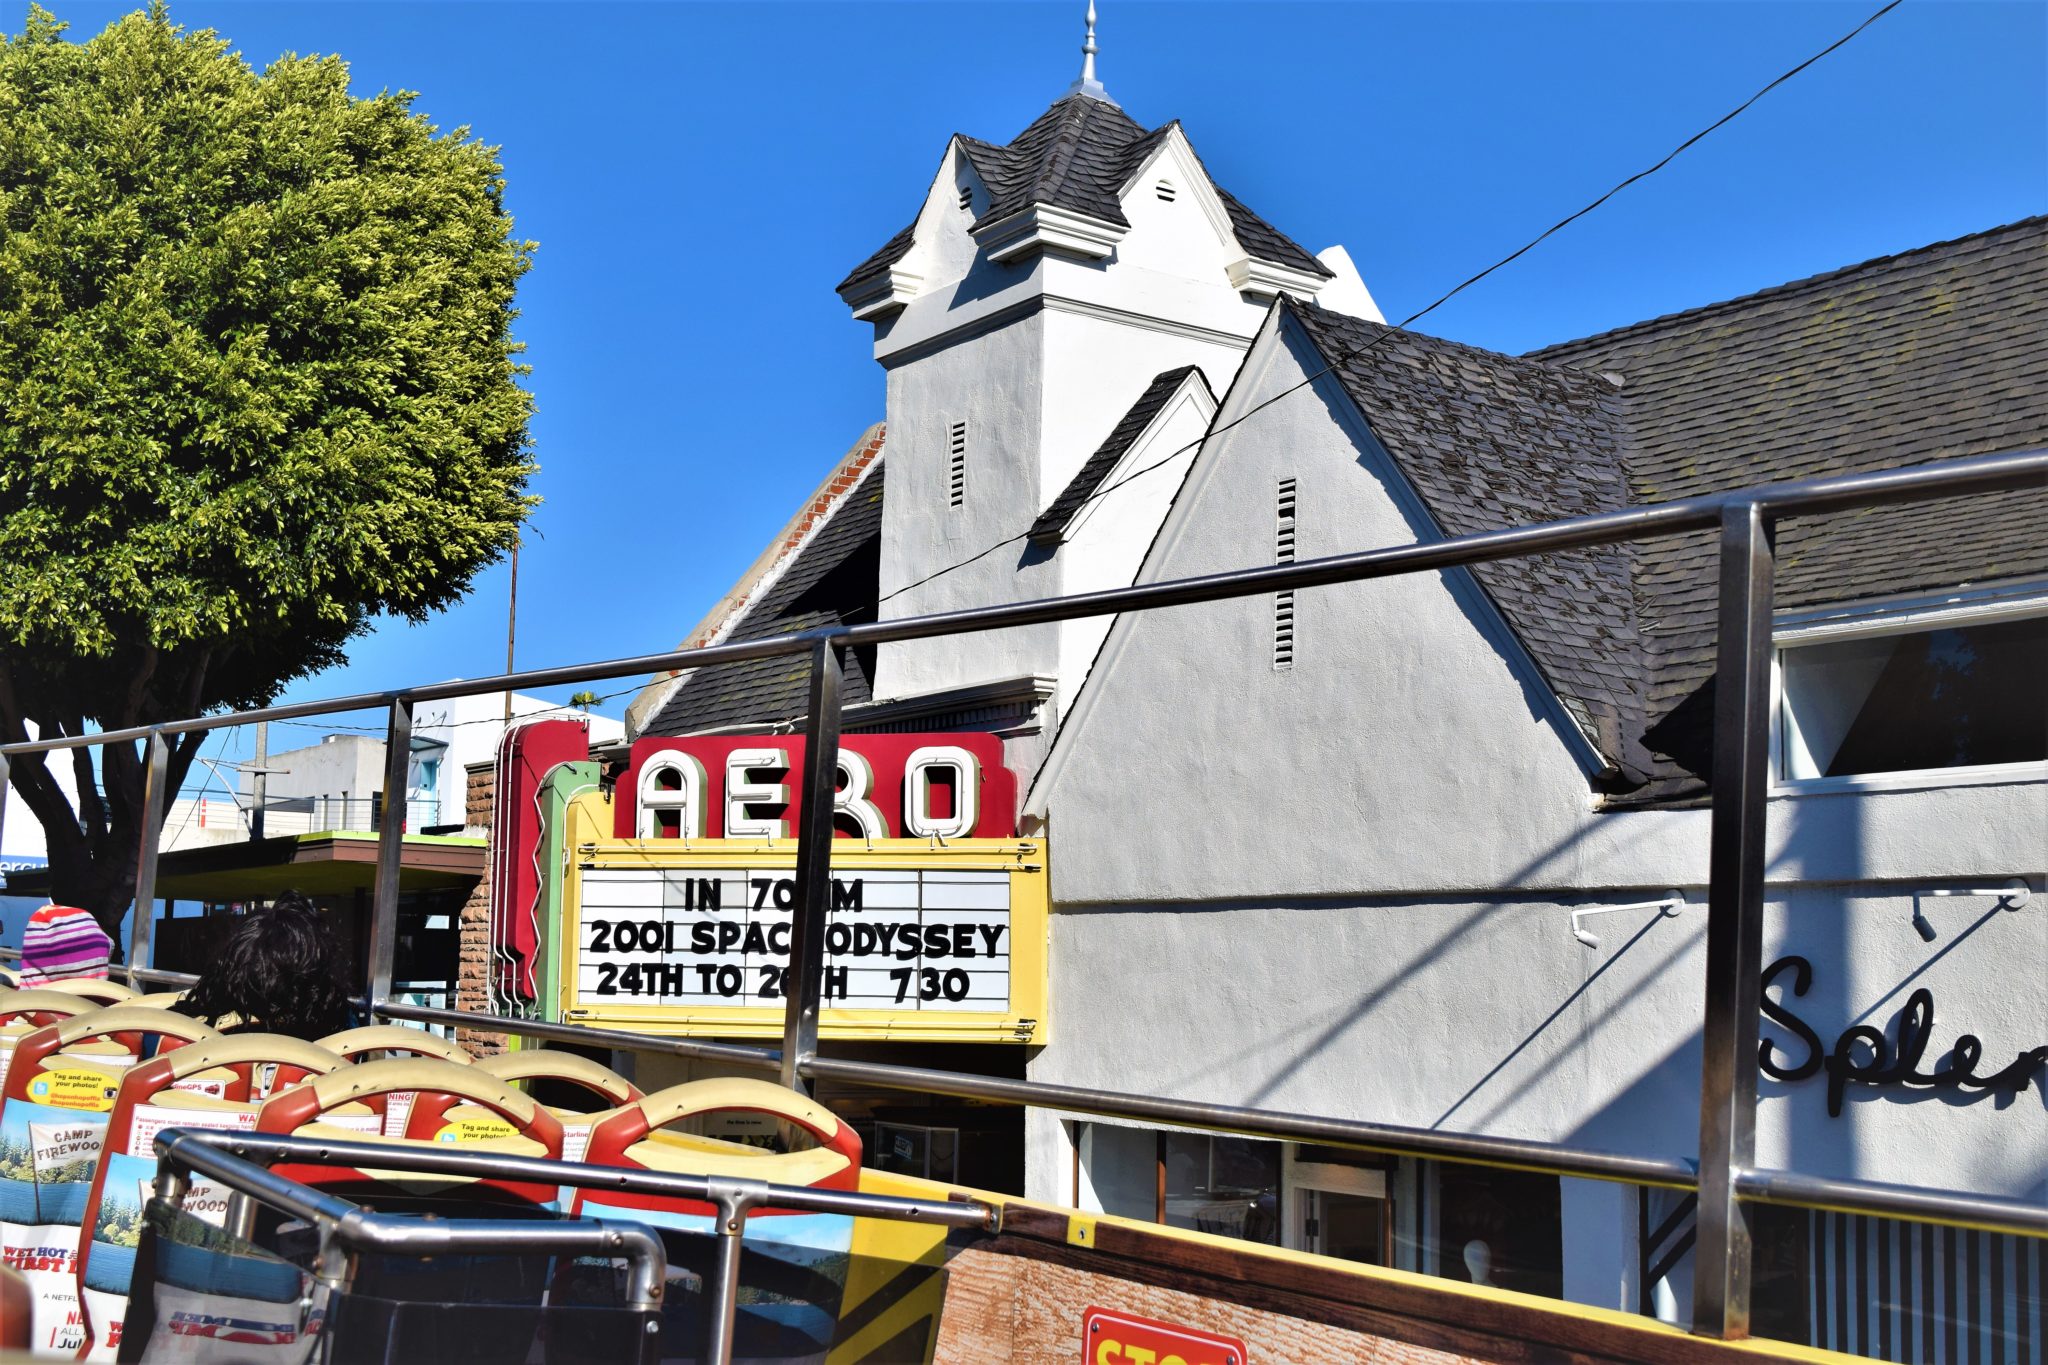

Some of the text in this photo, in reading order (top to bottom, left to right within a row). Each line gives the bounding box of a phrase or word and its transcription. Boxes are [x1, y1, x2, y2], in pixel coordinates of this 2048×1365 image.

[636, 746, 980, 839] AERO
[685, 878, 863, 912] IN 70M
[691, 921, 791, 955] SPAC
[825, 922, 1005, 961] ODYSSEY
[597, 962, 683, 997] 24TH
[696, 964, 742, 997] TO
[758, 964, 848, 999] 2H
[54, 1072, 66, 1080] Tag
[462, 1123, 474, 1132] Tag
[54, 1130, 93, 1143] CAMP
[37, 1141, 102, 1160] FIREWOO
[4, 1246, 35, 1257] WET
[37, 1247, 68, 1258] HOT
[3, 1256, 65, 1273] FIRST
[60, 1327, 80, 1336] ALL
